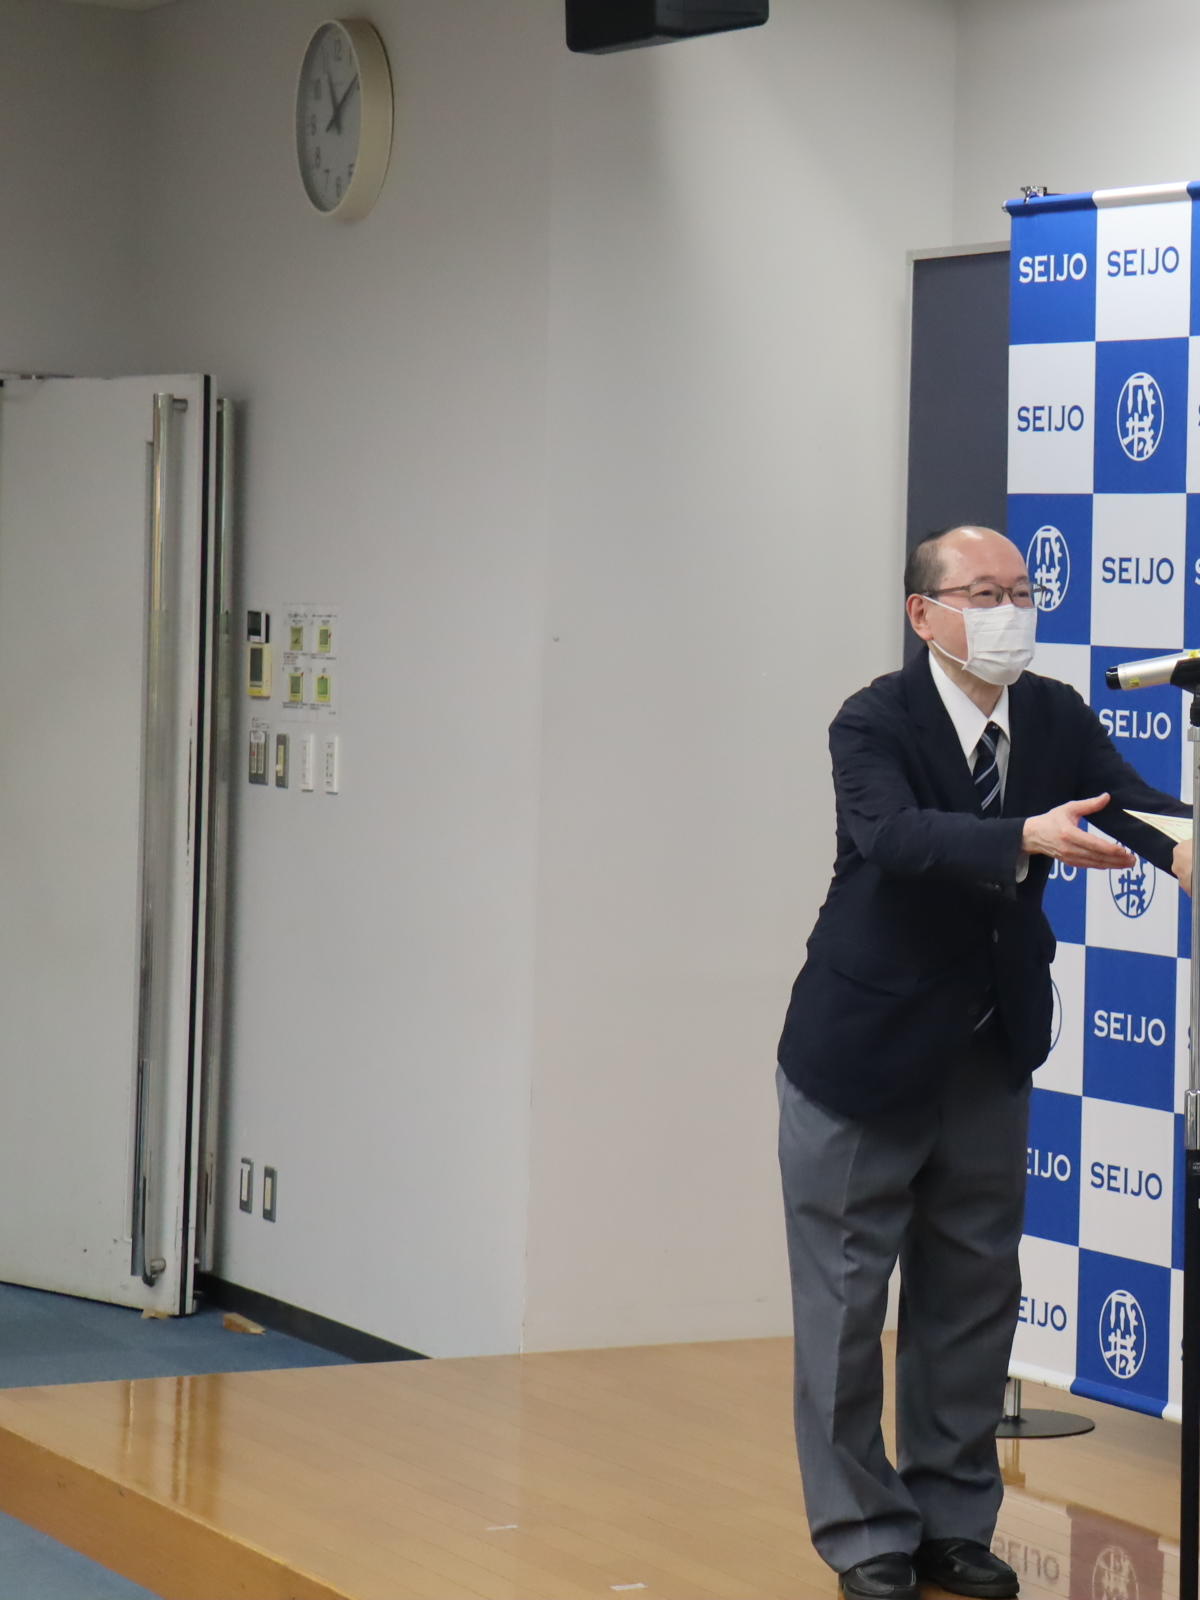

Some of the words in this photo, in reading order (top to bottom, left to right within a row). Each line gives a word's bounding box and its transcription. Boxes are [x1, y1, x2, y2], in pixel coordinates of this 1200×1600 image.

[1019, 253, 1087, 283] SEIJO
[1108, 247, 1179, 277] SEIJO
[1018, 405, 1084, 432] SEIJO
[1102, 557, 1174, 585] SEIJO
[1099, 709, 1171, 739] SEIJO
[1094, 1010, 1165, 1046] SEIJO
[1027, 1148, 1071, 1181] IJO
[1091, 1162, 1162, 1200] SEIJO
[1018, 1297, 1067, 1331] EIJO
